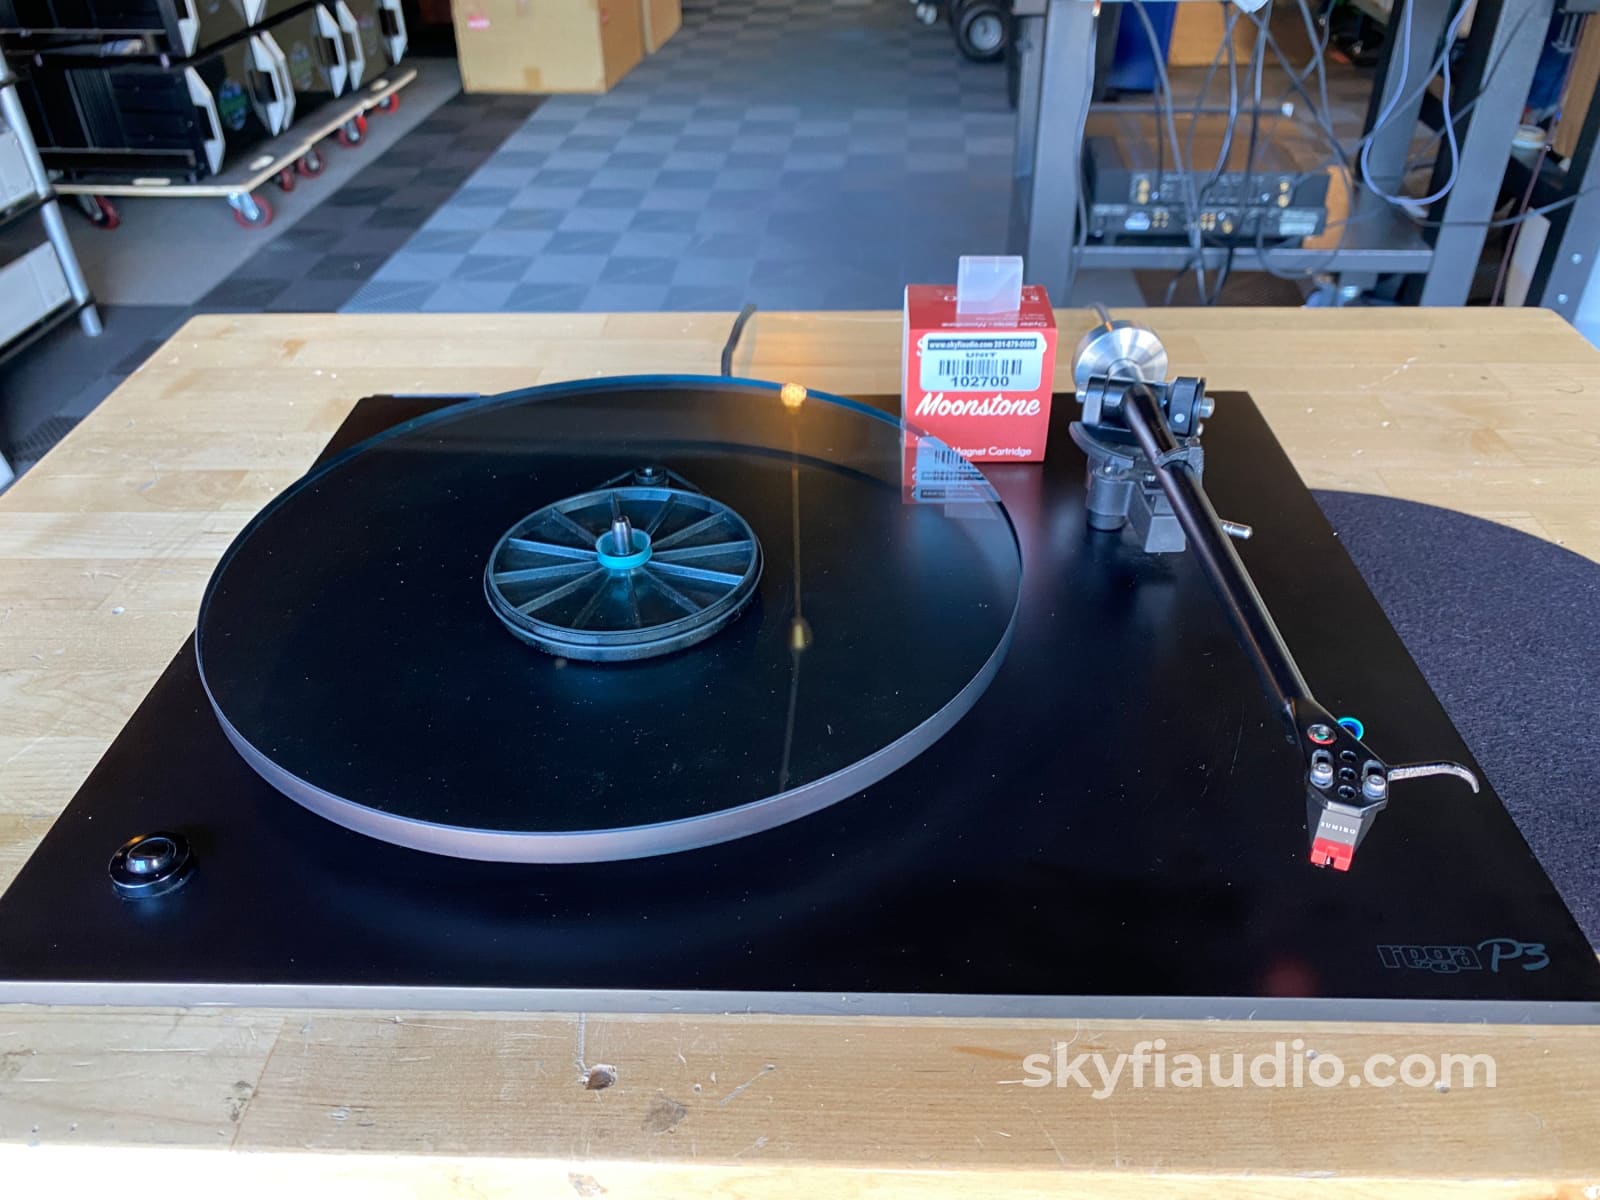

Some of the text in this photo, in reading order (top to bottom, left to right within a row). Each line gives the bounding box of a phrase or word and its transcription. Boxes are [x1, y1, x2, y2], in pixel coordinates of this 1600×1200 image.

[951, 375, 1010, 388] 102700
[914, 392, 1041, 417] Moonstone
[952, 446, 1032, 457] Magnet Cartridge
[1320, 821, 1356, 835] SUMIKO
[1376, 937, 1551, 974] rega P3
